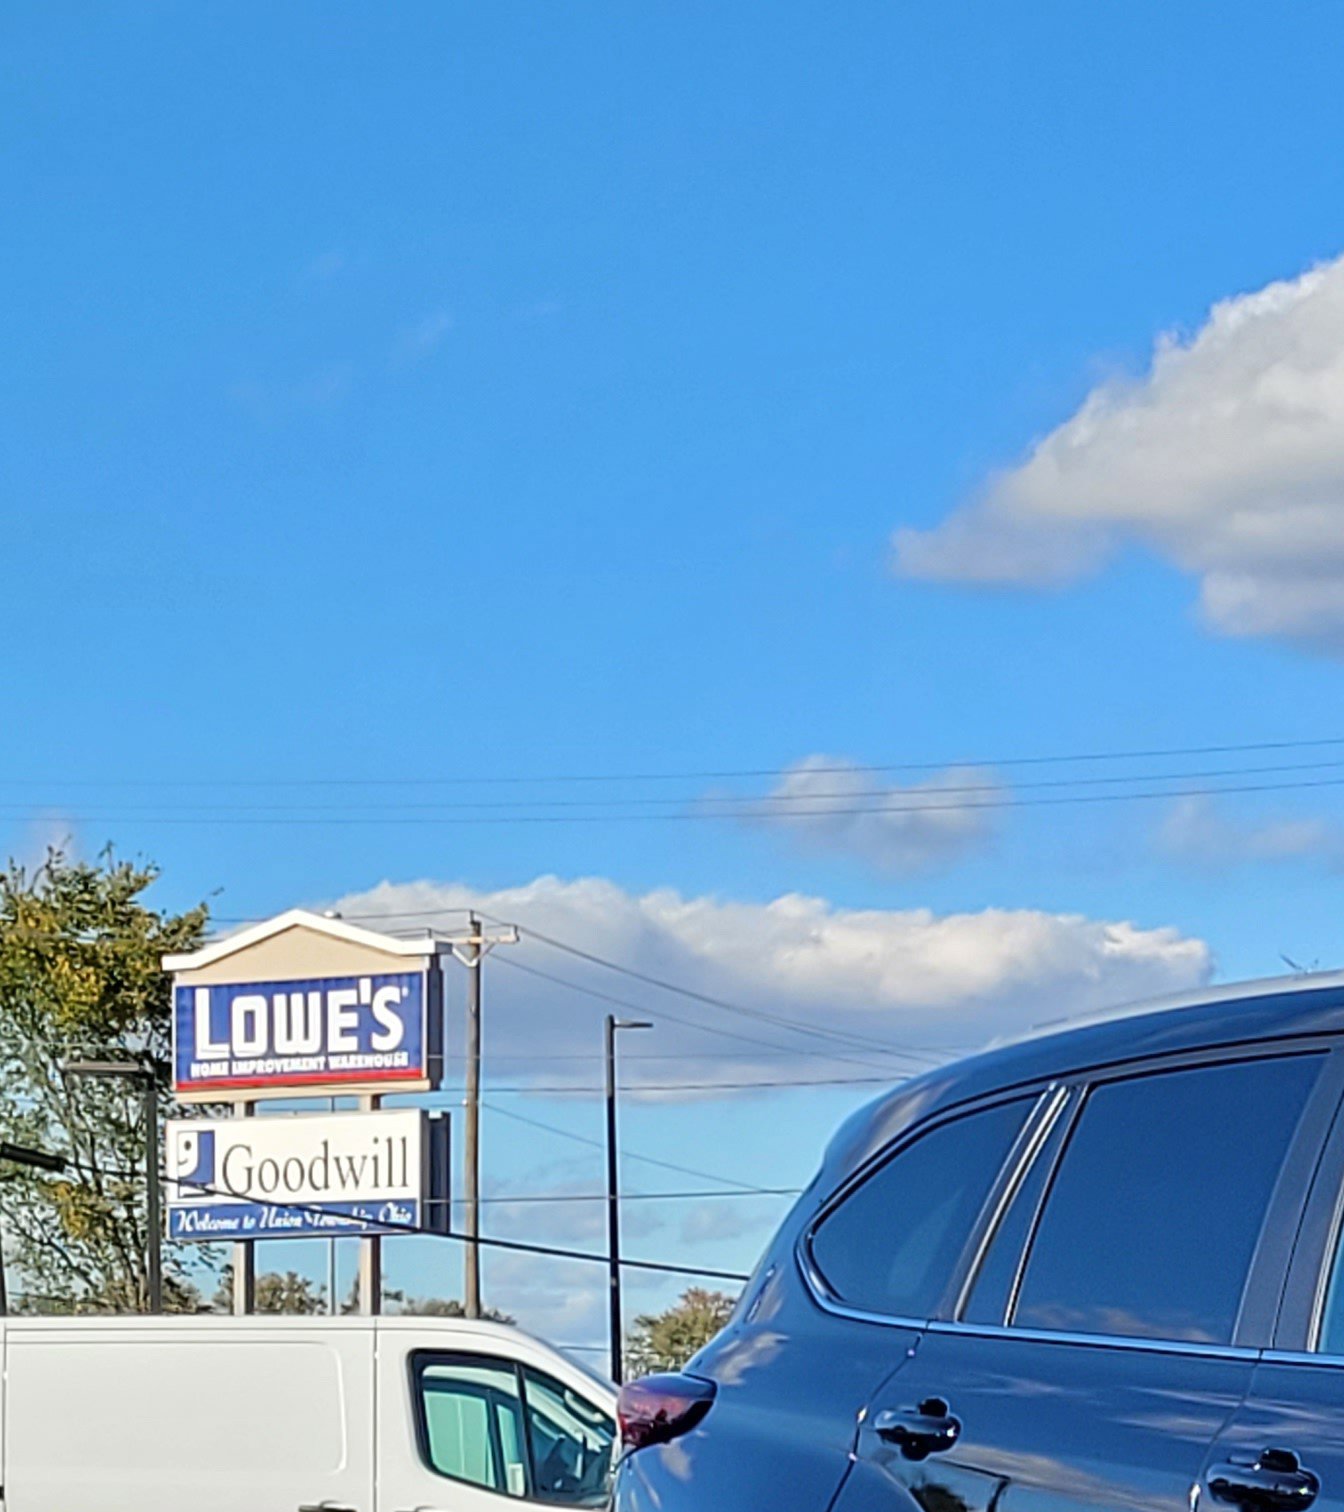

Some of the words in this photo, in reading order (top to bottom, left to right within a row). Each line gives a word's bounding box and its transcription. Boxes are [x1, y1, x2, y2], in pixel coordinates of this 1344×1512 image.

[195, 978, 404, 1060] LOWE'S
[191, 1061, 229, 1079] HOME
[231, 1056, 326, 1075] IMPROVEMENT
[328, 1051, 409, 1071] WAREHOUSE
[222, 1136, 409, 1196] Goodwill
[176, 1209, 240, 1232] Welcome
[242, 1215, 256, 1230] to
